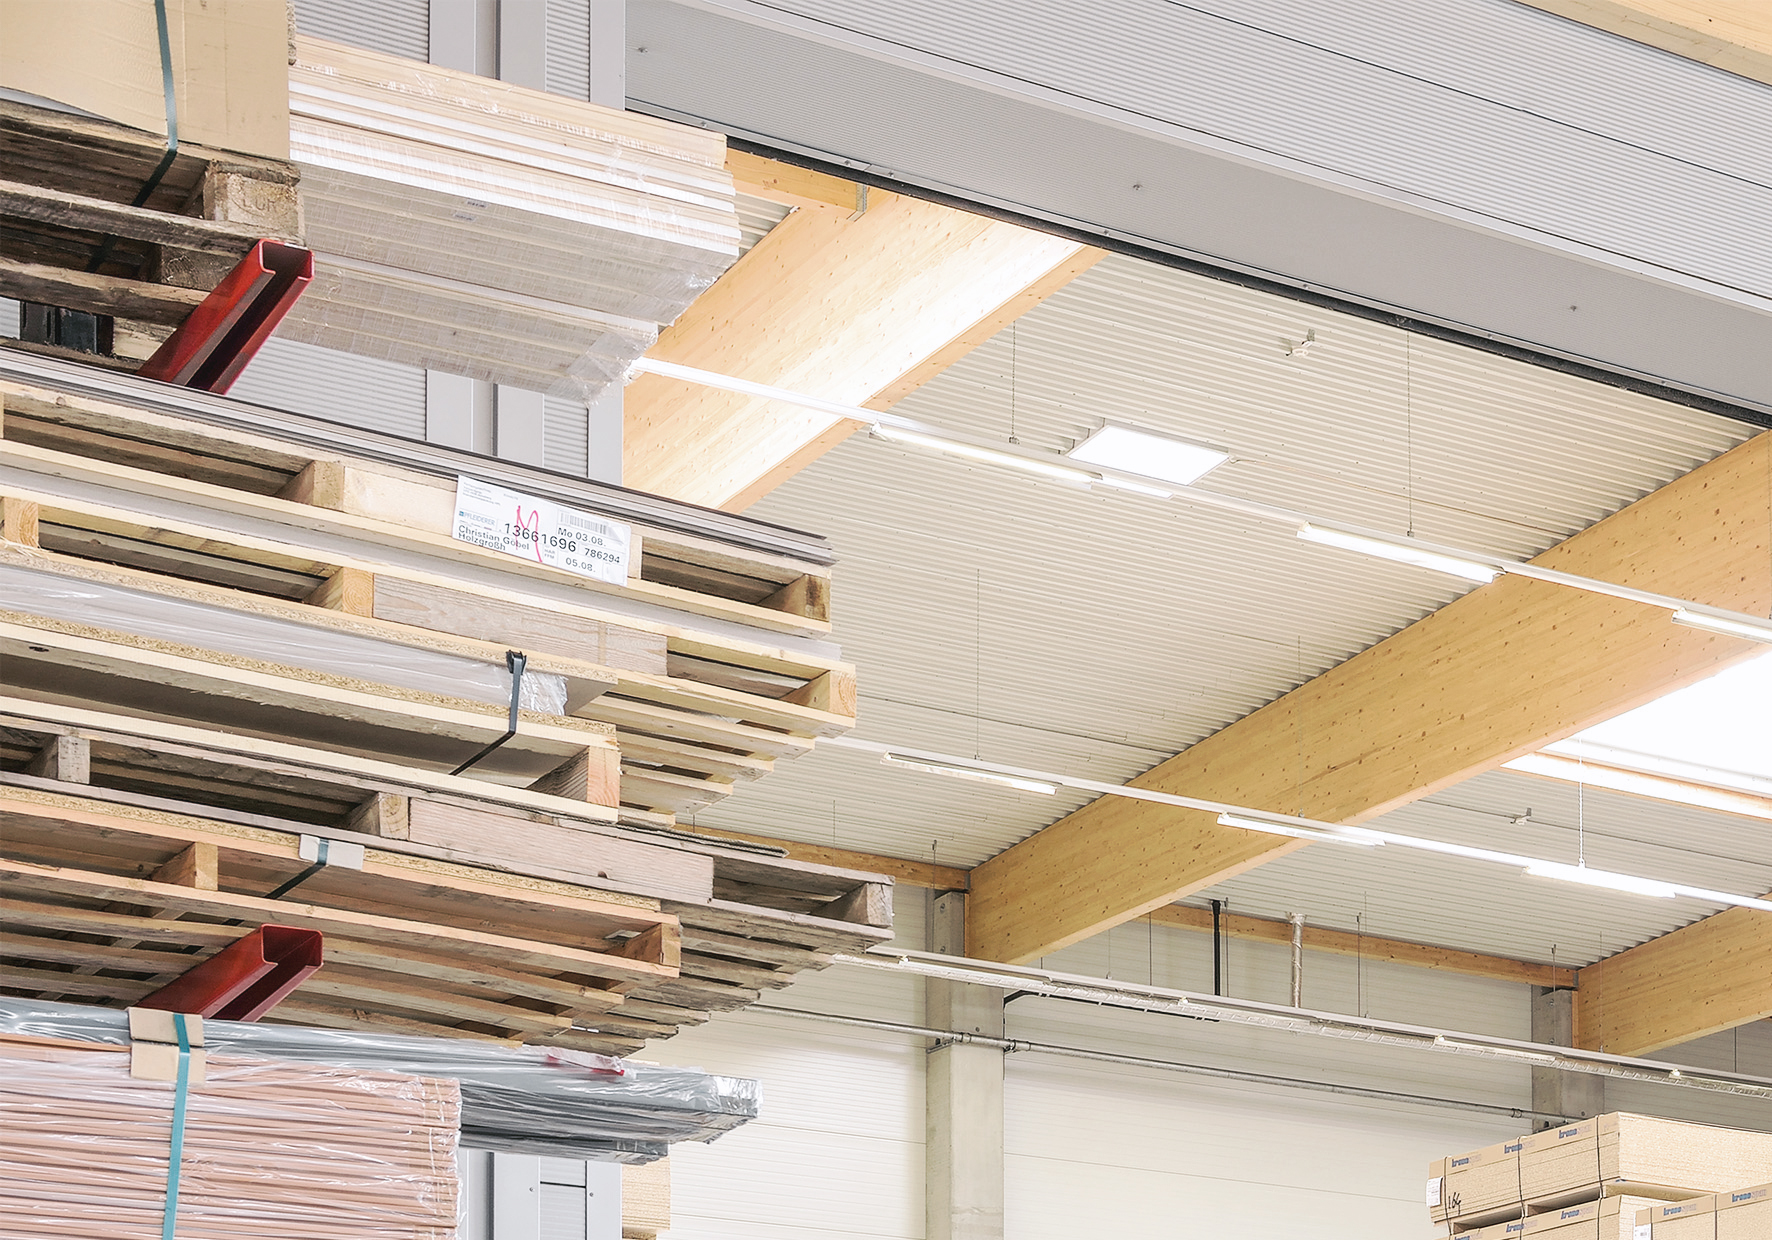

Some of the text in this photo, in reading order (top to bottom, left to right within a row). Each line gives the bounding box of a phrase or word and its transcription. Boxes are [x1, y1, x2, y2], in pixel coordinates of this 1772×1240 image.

[458, 524, 500, 542] Christian
[505, 523, 577, 552] 13661696
[557, 527, 607, 547] Mo 03.08.
[584, 547, 620, 563] 786294
[565, 557, 596, 573] 05.08.
